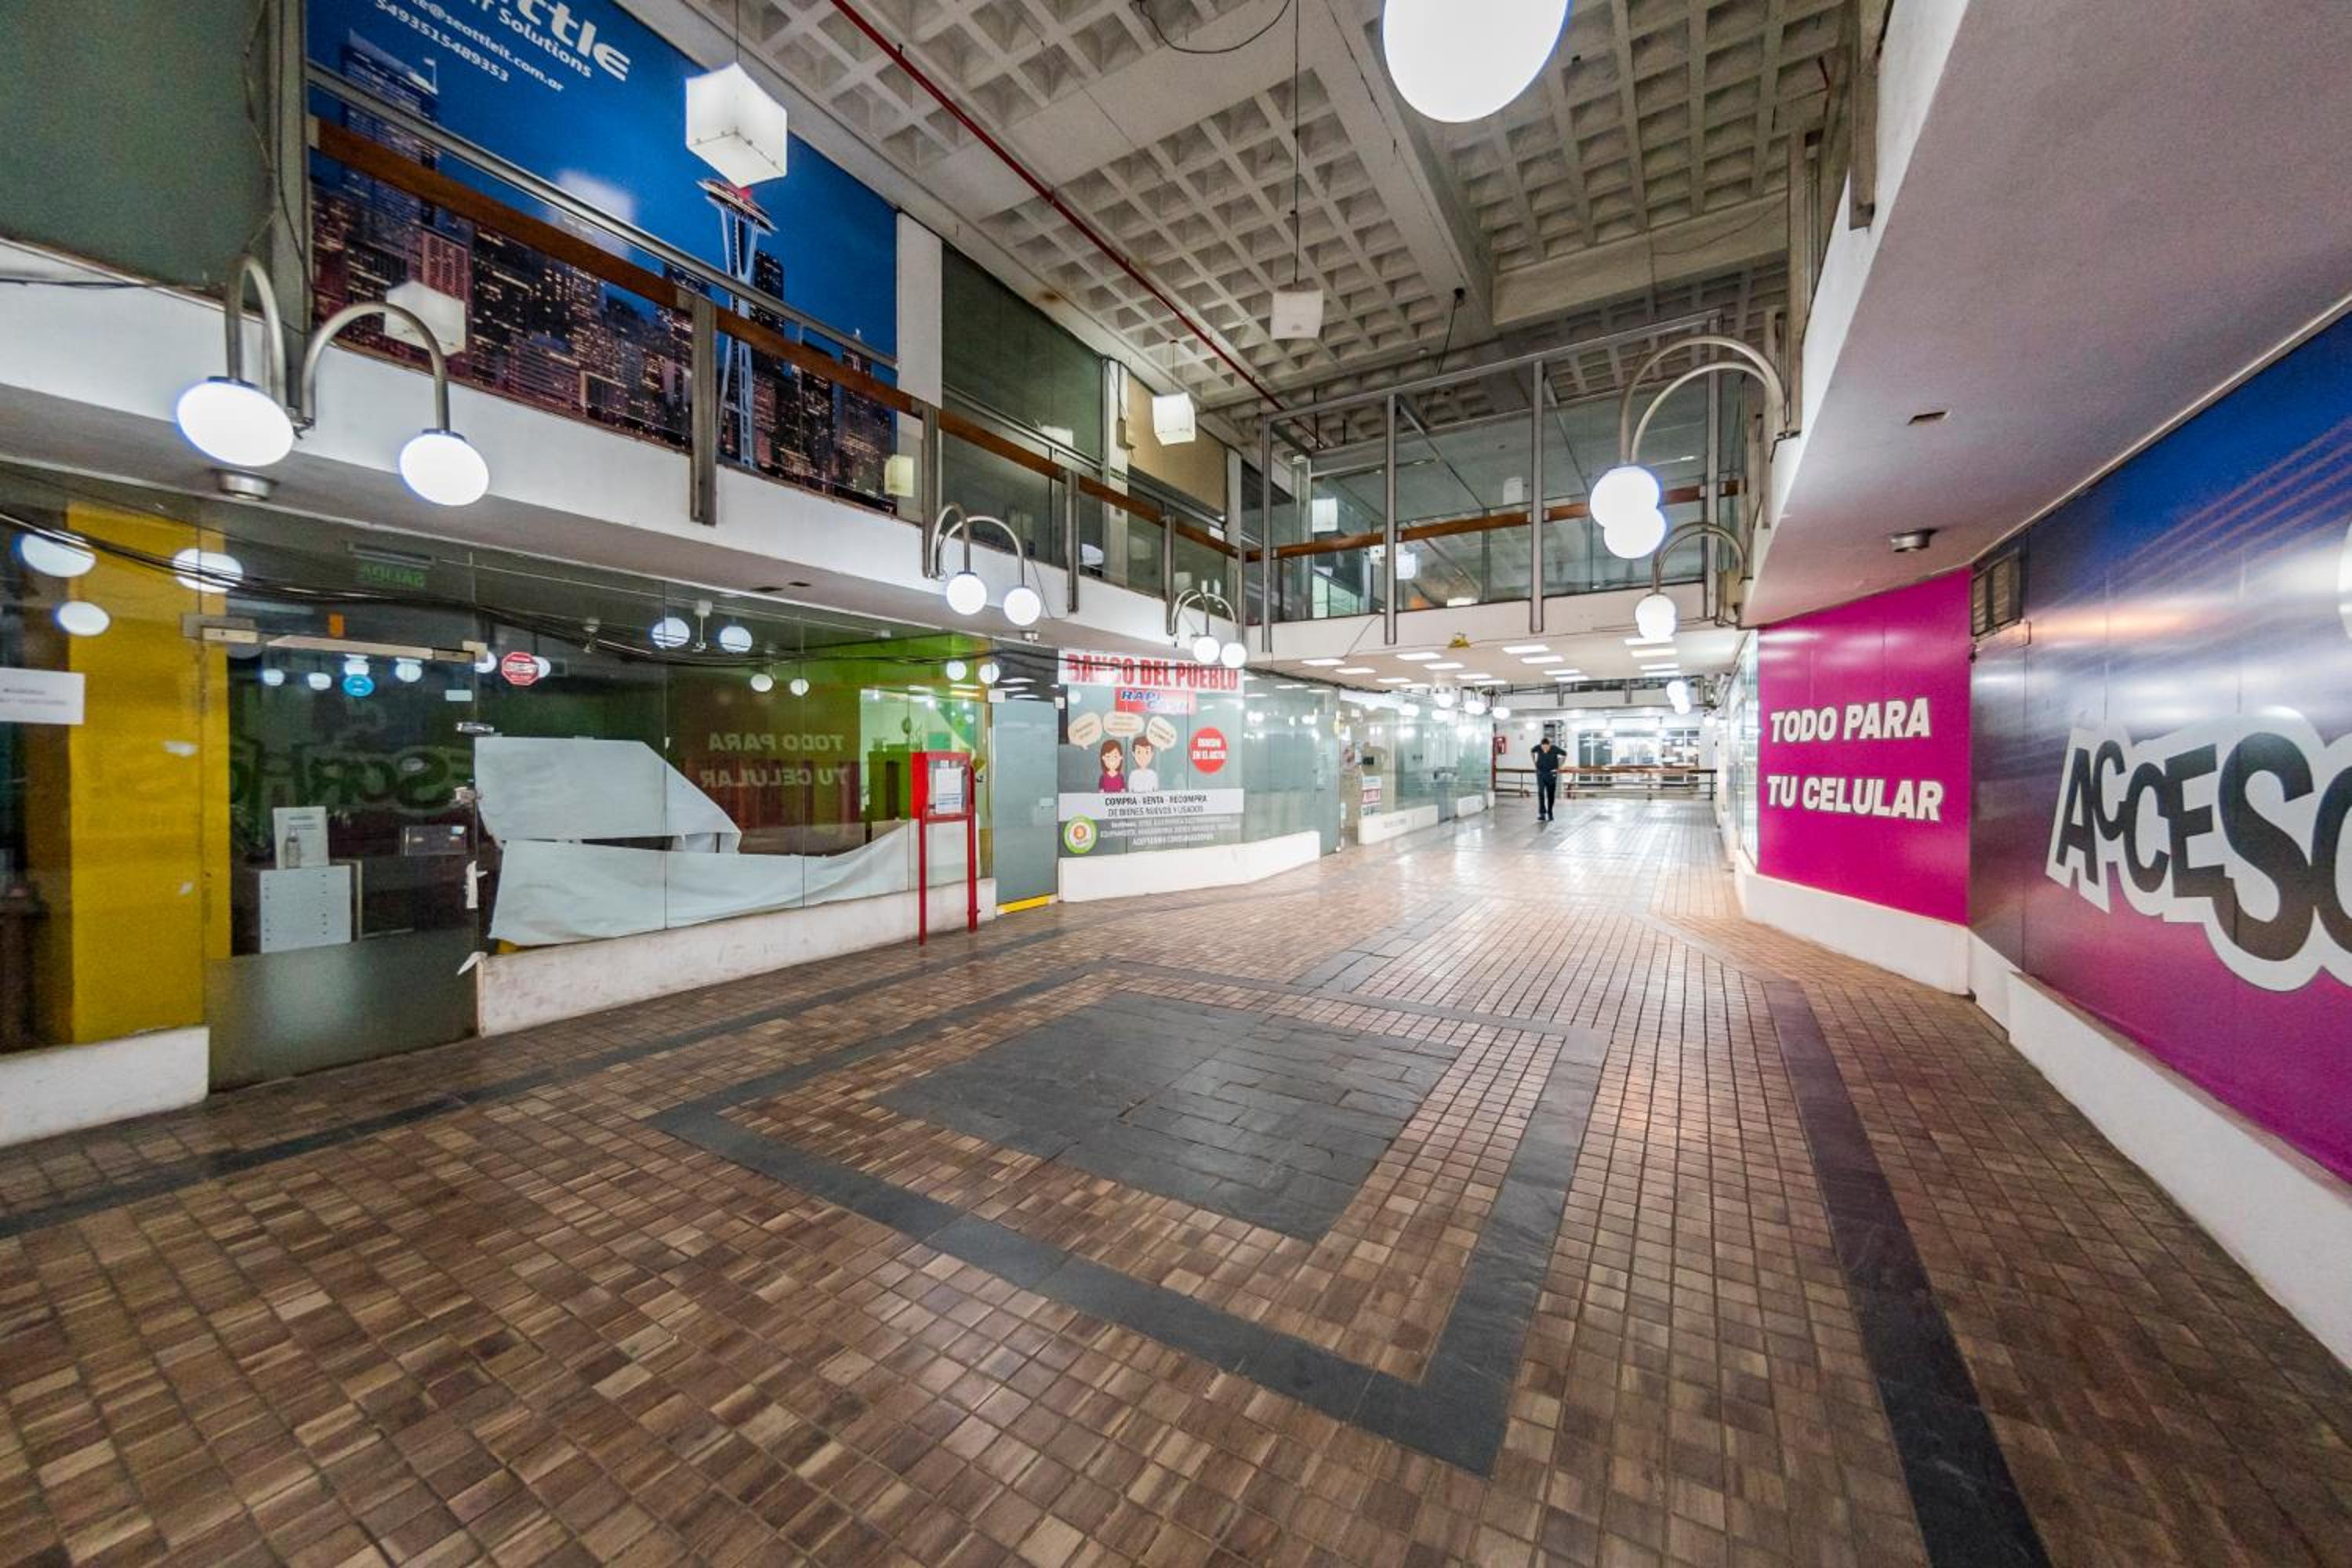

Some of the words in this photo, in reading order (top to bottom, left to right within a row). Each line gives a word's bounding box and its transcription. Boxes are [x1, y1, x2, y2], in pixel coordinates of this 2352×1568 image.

[498, 6, 592, 78] Solutions
[502, 0, 631, 82] ttle
[1140, 659, 1171, 686] DEL
[1176, 662, 1238, 691] PUEBLO
[1770, 706, 1838, 742] TODO
[1843, 697, 1931, 741] PARA
[1105, 797, 1138, 807] COMPRA
[1767, 775, 1798, 808] TU
[1802, 777, 1944, 822] CELULAR
